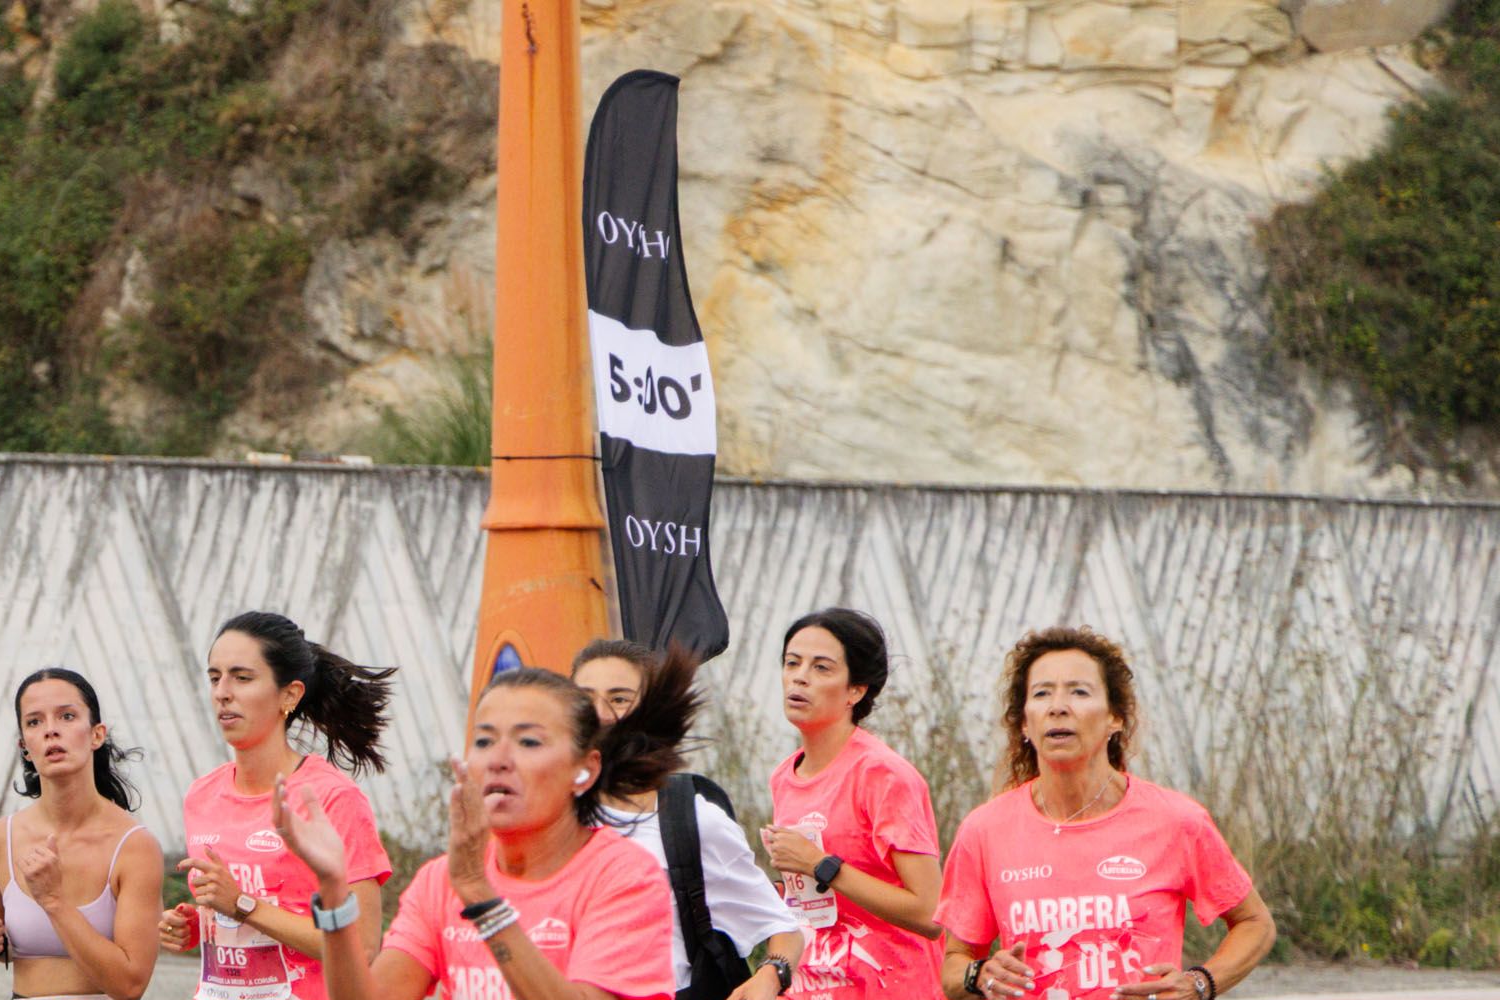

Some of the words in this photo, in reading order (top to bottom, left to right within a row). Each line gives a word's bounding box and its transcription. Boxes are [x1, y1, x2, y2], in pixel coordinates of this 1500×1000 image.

[1001, 864, 1053, 882] OYSHO
[1102, 864, 1143, 875] ASTURIANA
[786, 872, 804, 891] 16
[1010, 893, 1133, 936] CARRERA
[217, 947, 247, 966] 016
[1079, 942, 1119, 989] DE
